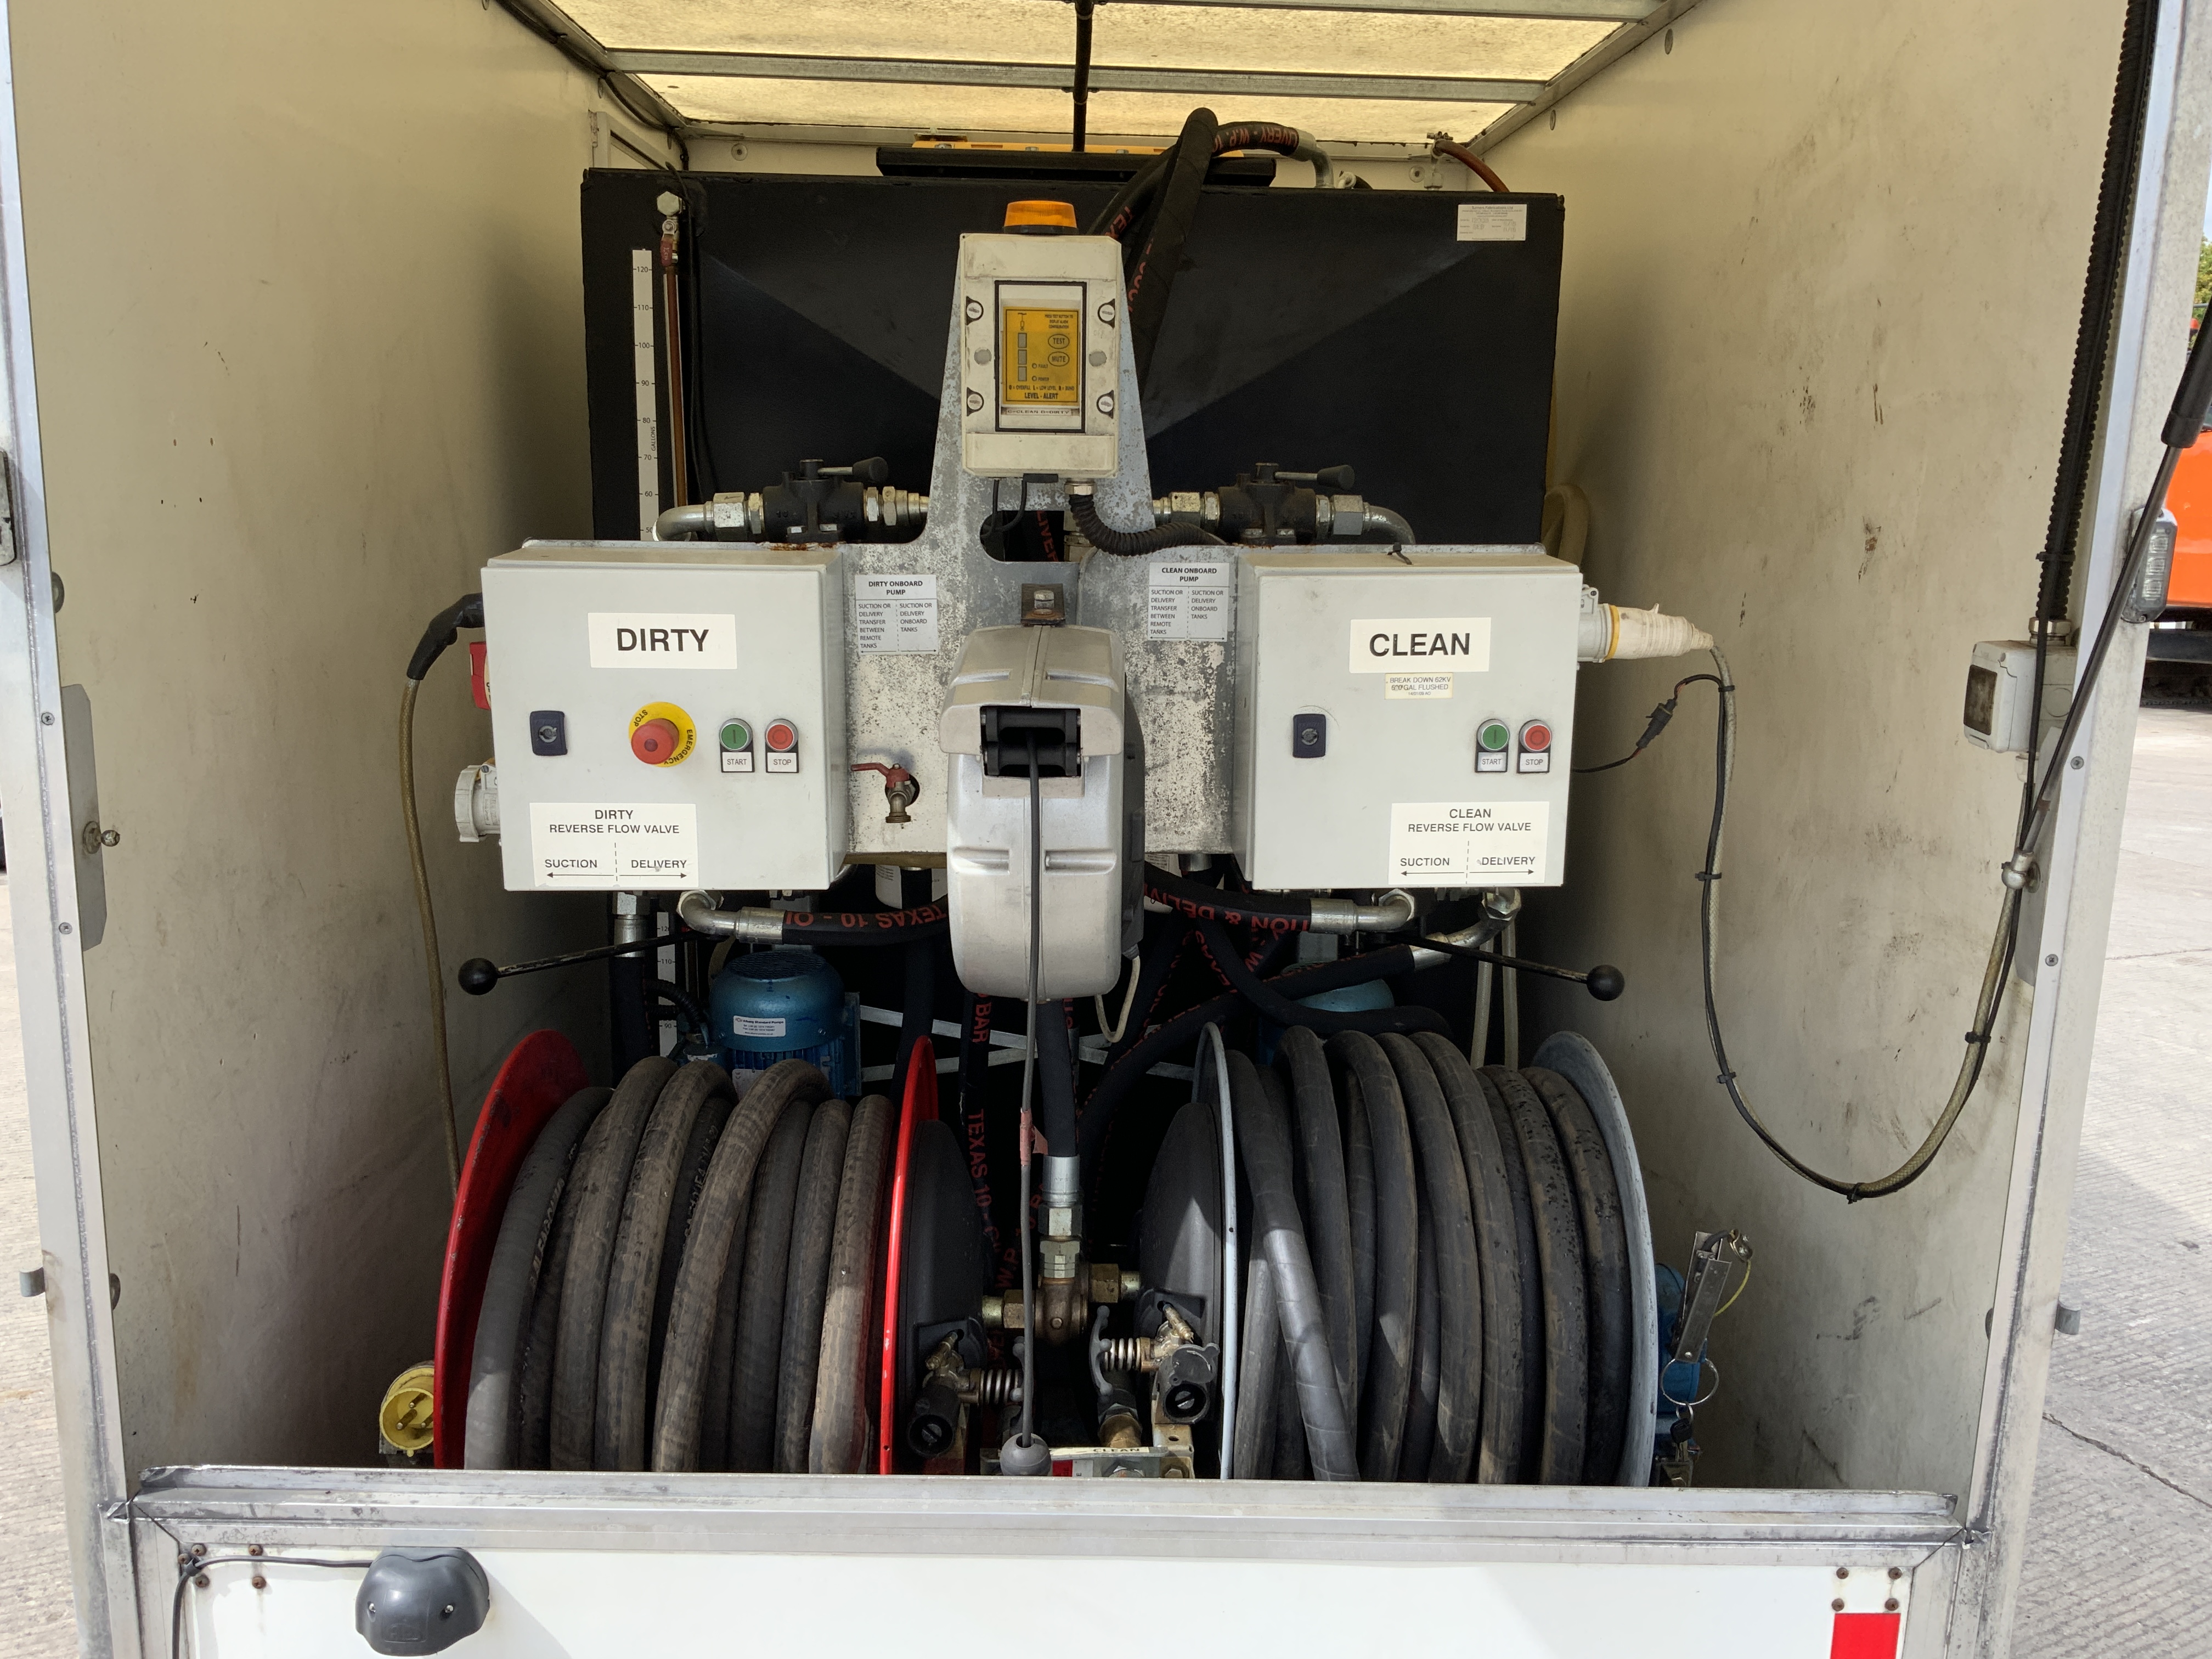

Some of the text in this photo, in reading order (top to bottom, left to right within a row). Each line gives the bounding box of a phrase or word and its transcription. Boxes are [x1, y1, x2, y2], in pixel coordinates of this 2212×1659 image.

[617, 628, 709, 652] DIRTY
[1369, 633, 1470, 657] CLEAN
[634, 709, 648, 727] STOP
[595, 809, 634, 820] DIRTY
[1449, 809, 1492, 819] CLEAN
[549, 824, 680, 834] REVERSE FLOW VALVE
[1408, 822, 1531, 833] REVERSE FLOW VALVE
[545, 859, 597, 869] SUCTION
[630, 859, 687, 869] DELIVERY
[1400, 857, 1450, 867] SUCTION
[1481, 856, 1536, 866] DELIVERY
[841, 912, 868, 928] 10
[875, 904, 947, 929] TEXAS
[1224, 910, 1242, 925] &
[968, 1108, 989, 1178] TEXAS
